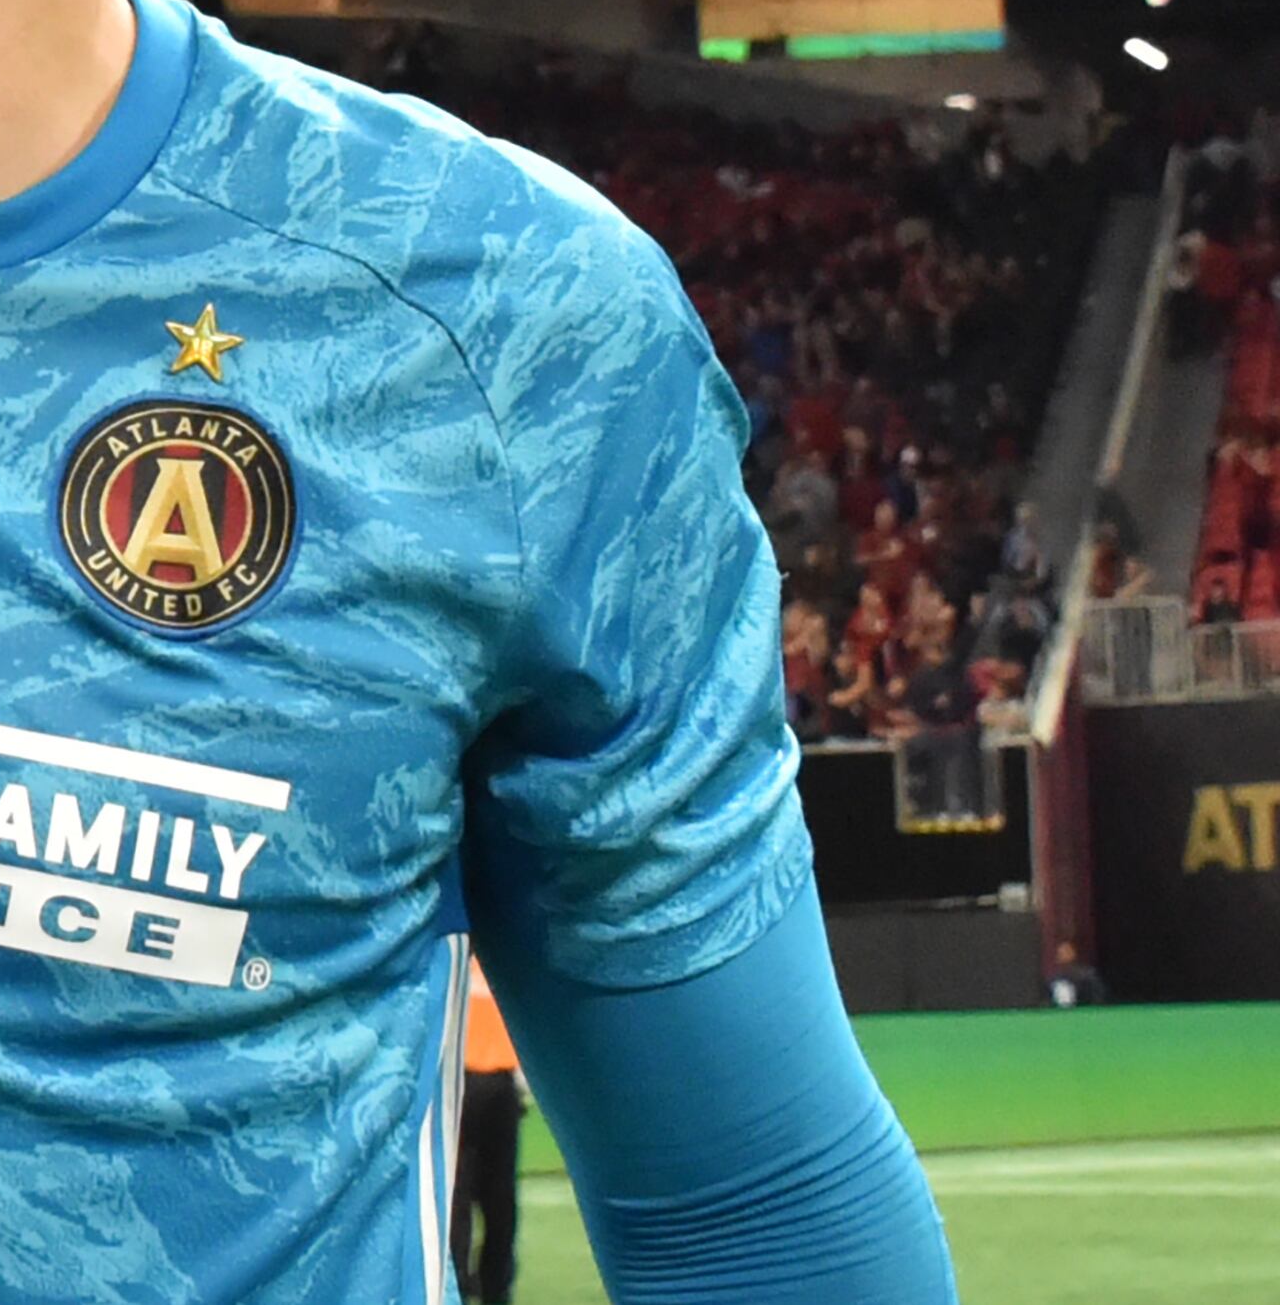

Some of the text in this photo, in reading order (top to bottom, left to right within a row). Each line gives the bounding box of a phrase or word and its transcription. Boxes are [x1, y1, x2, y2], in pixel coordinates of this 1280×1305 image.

[105, 415, 259, 467] ATLANTA
[122, 457, 226, 582] A
[86, 549, 258, 617] UNITED FC
